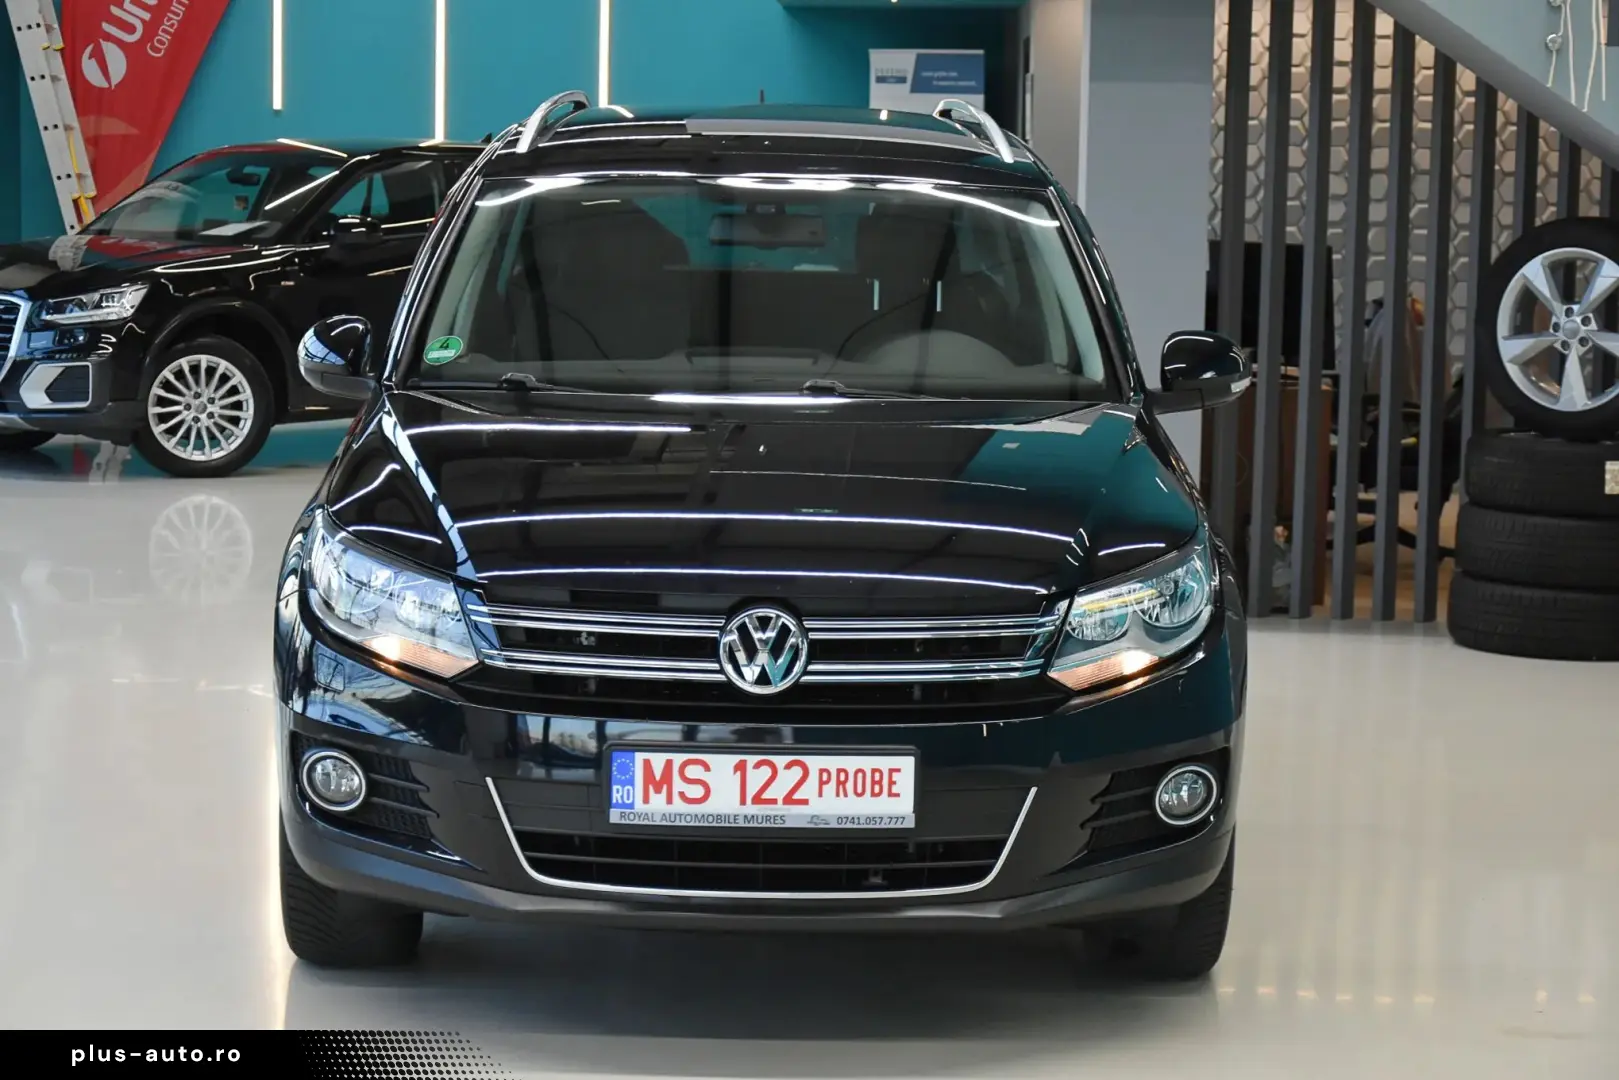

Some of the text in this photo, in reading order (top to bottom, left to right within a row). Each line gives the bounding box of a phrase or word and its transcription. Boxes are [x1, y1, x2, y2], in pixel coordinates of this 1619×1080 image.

[438, 337, 450, 350] 4
[642, 758, 902, 806] MS 122 PROBE
[611, 785, 634, 804] RO
[619, 811, 906, 826] ROYAL AUTOMOBILE MURES 0741.057.777
